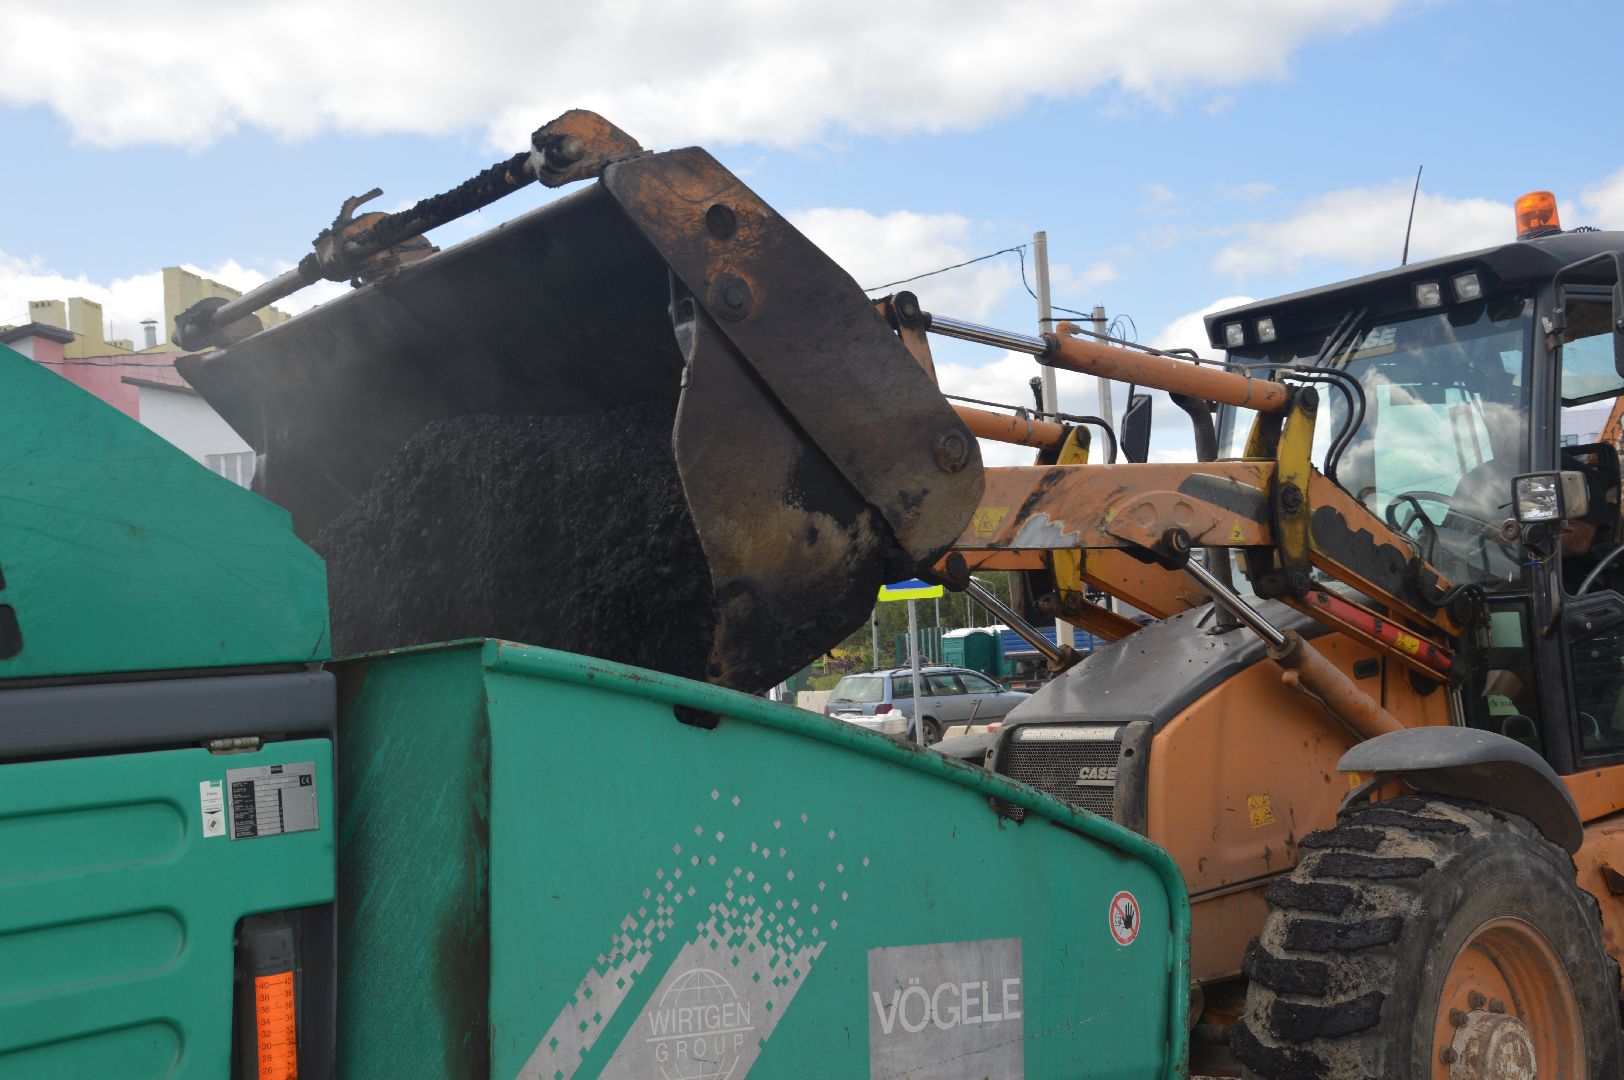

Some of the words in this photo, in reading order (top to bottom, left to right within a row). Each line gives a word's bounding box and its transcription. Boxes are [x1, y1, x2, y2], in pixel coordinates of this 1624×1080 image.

[1080, 767, 1118, 780] CASE
[872, 977, 1022, 1035] VÖGELE
[261, 1018, 270, 1026] 34
[648, 1001, 751, 1036] WIRTGEN
[261, 1030, 271, 1038] 32
[262, 1042, 271, 1050] 30
[655, 1033, 744, 1063] GROUP
